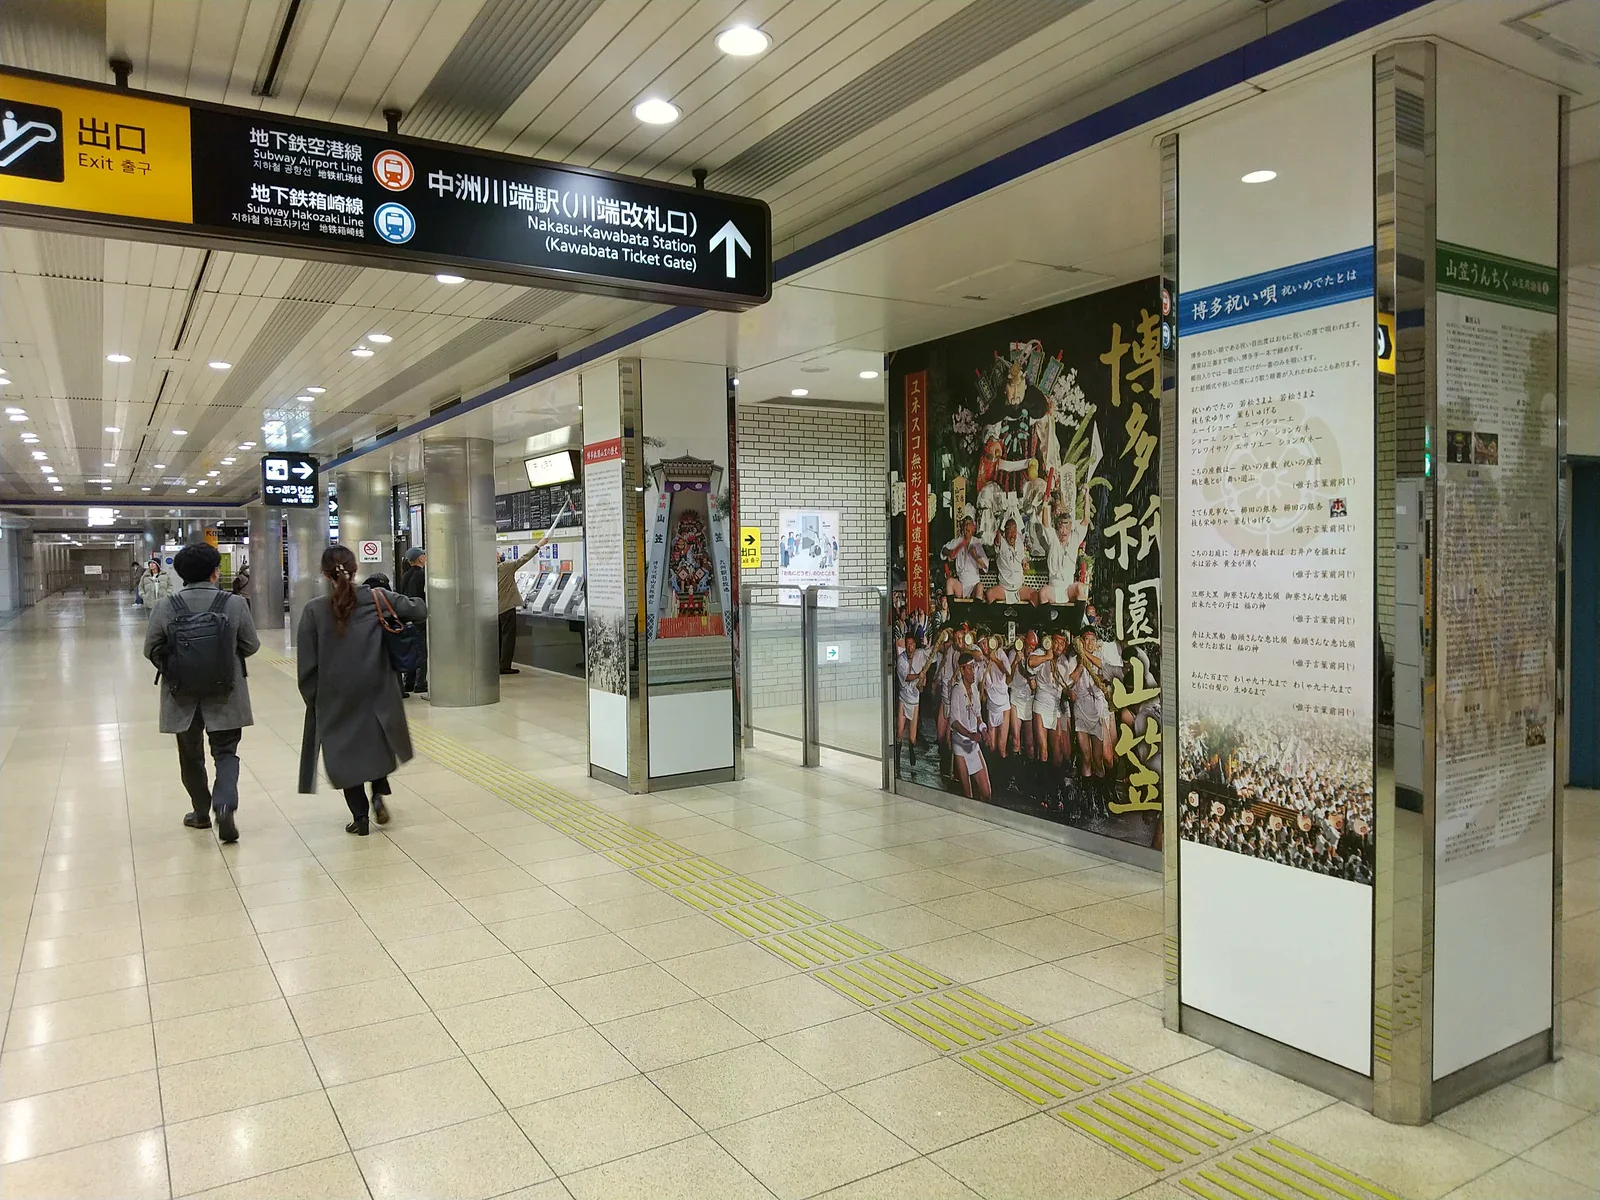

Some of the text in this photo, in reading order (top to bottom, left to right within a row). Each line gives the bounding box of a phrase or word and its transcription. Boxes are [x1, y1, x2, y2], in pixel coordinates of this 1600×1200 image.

[79, 117, 146, 154] 出口
[250, 128, 362, 161] 地下鉄空港線
[78, 154, 152, 176] Exit 출구
[253, 160, 281, 172] 지하철
[284, 164, 312, 177] 공항선
[254, 149, 363, 174] Subway Airport Line
[251, 183, 364, 216] 地下鉄箱崎線
[232, 213, 260, 225] 지하철
[247, 204, 364, 227] Subway Hakozaki Line
[528, 216, 696, 254] Nakasu-Kawabata Station
[545, 237, 697, 273] (Kawabata Ticket Gate)
[1446, 259, 1509, 291] 山笠うんちく
[1192, 269, 1357, 321] 博多祝い唄 祝いめでたとは
[266, 485, 313, 494] きっぷうりば
[910, 380, 925, 598] ユネスコ無形文化遺産登録
[655, 514, 665, 544] 山笠
[712, 514, 723, 543] 山笠
[741, 548, 756, 556] 出口
[1100, 308, 1162, 814] 博多祇園山笠
